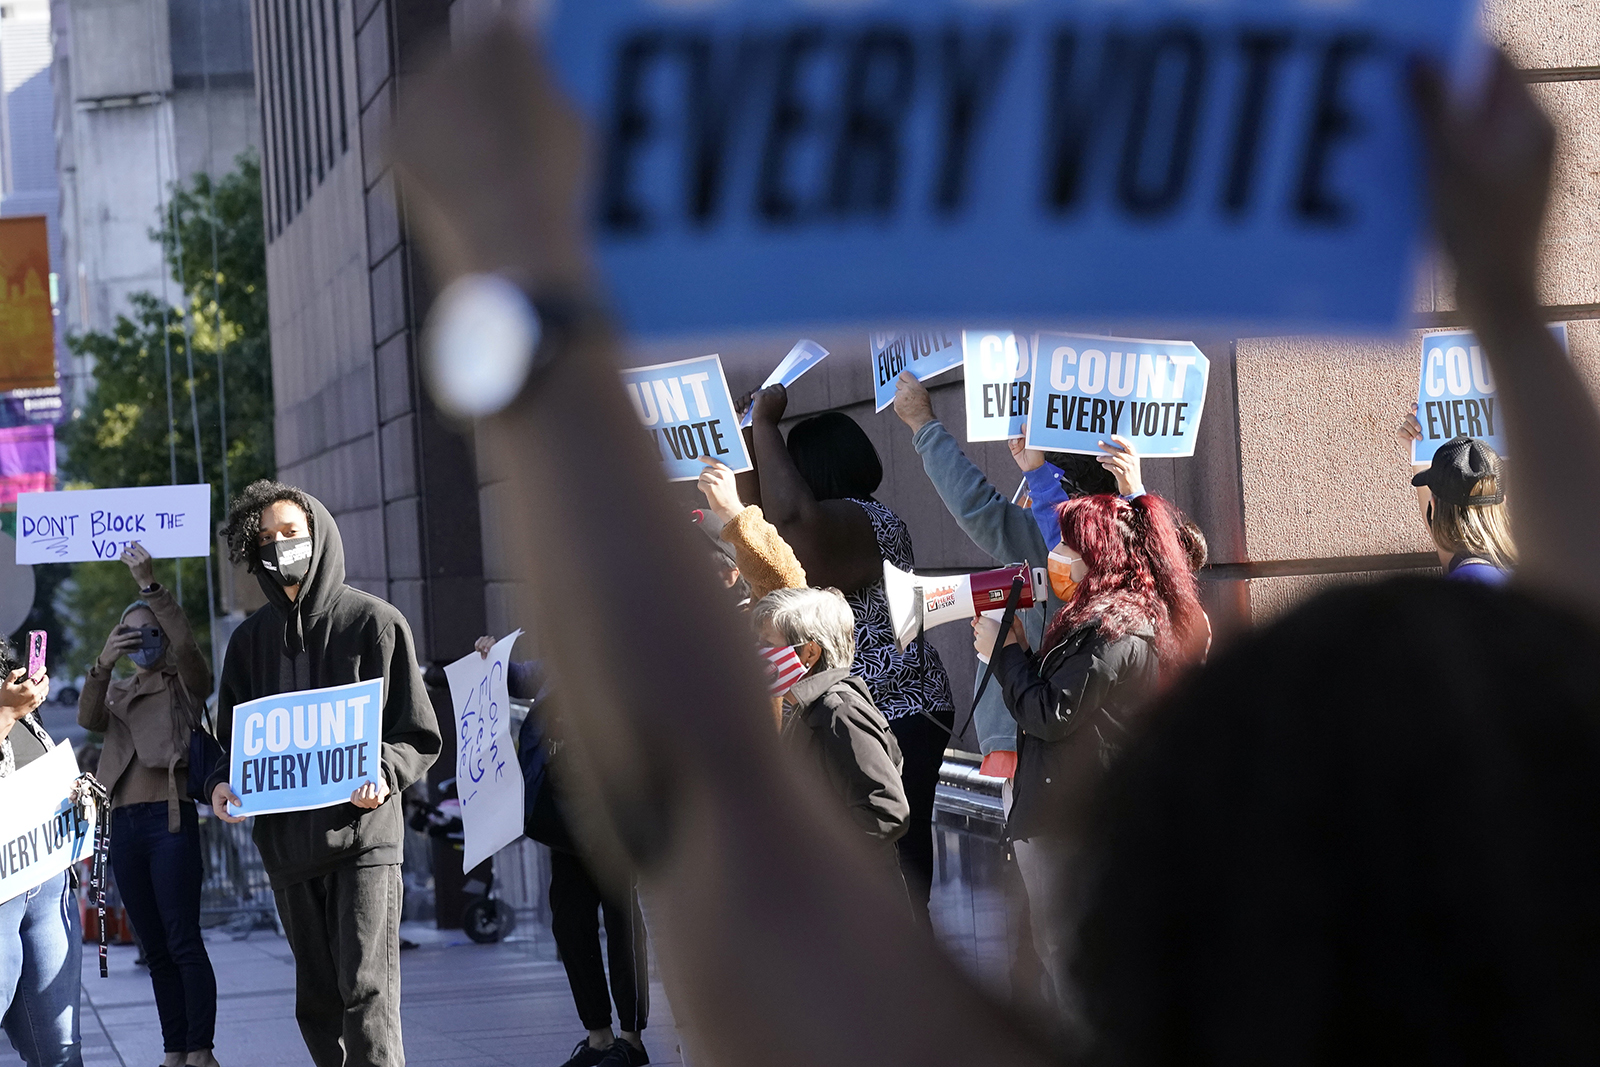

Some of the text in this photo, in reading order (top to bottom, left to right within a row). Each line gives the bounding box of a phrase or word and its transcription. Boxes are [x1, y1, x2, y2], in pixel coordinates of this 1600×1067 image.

[598, 24, 1384, 236] EVERY VOTE
[877, 335, 907, 387] EVERY
[1050, 346, 1196, 399] COUNT
[1425, 346, 1497, 397] COU
[626, 371, 711, 426] UNT
[983, 381, 1032, 418] EVER
[1045, 393, 1188, 437] EVERY VOTE
[1425, 398, 1495, 440] EVERY
[662, 419, 729, 460] VOTE
[22, 514, 79, 537] DON'T
[155, 513, 185, 530] THE
[243, 695, 371, 757] COUNT
[241, 741, 369, 795] EVERY VOTE
[0, 827, 38, 880] VERY
[42, 805, 85, 856] VOTE
